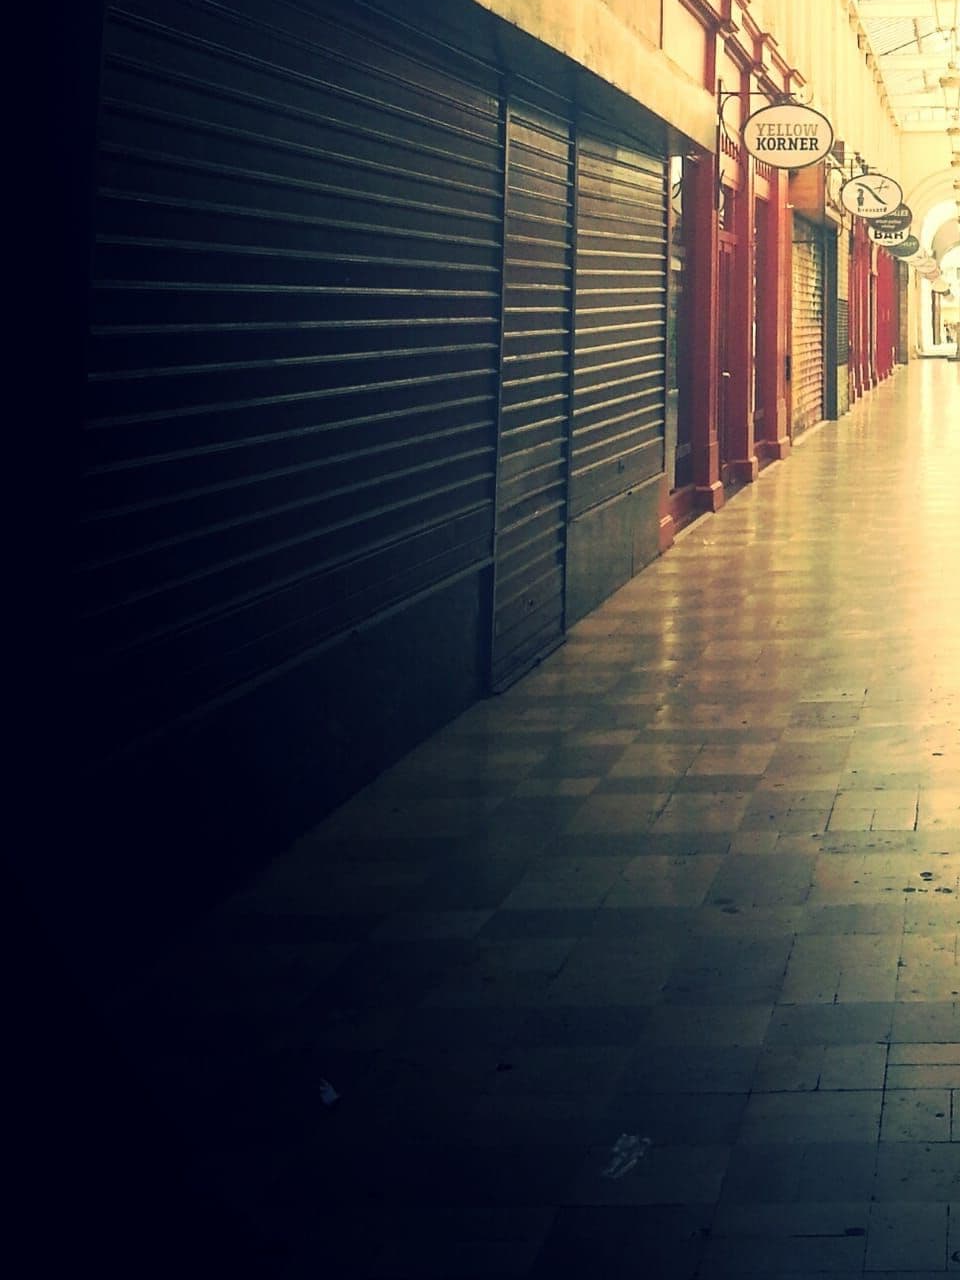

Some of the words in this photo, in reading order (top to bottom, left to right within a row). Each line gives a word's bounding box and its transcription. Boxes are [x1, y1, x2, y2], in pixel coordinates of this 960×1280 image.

[756, 123, 818, 136] YELLOW
[756, 137, 819, 151] KORNER
[873, 230, 905, 240] BAR
